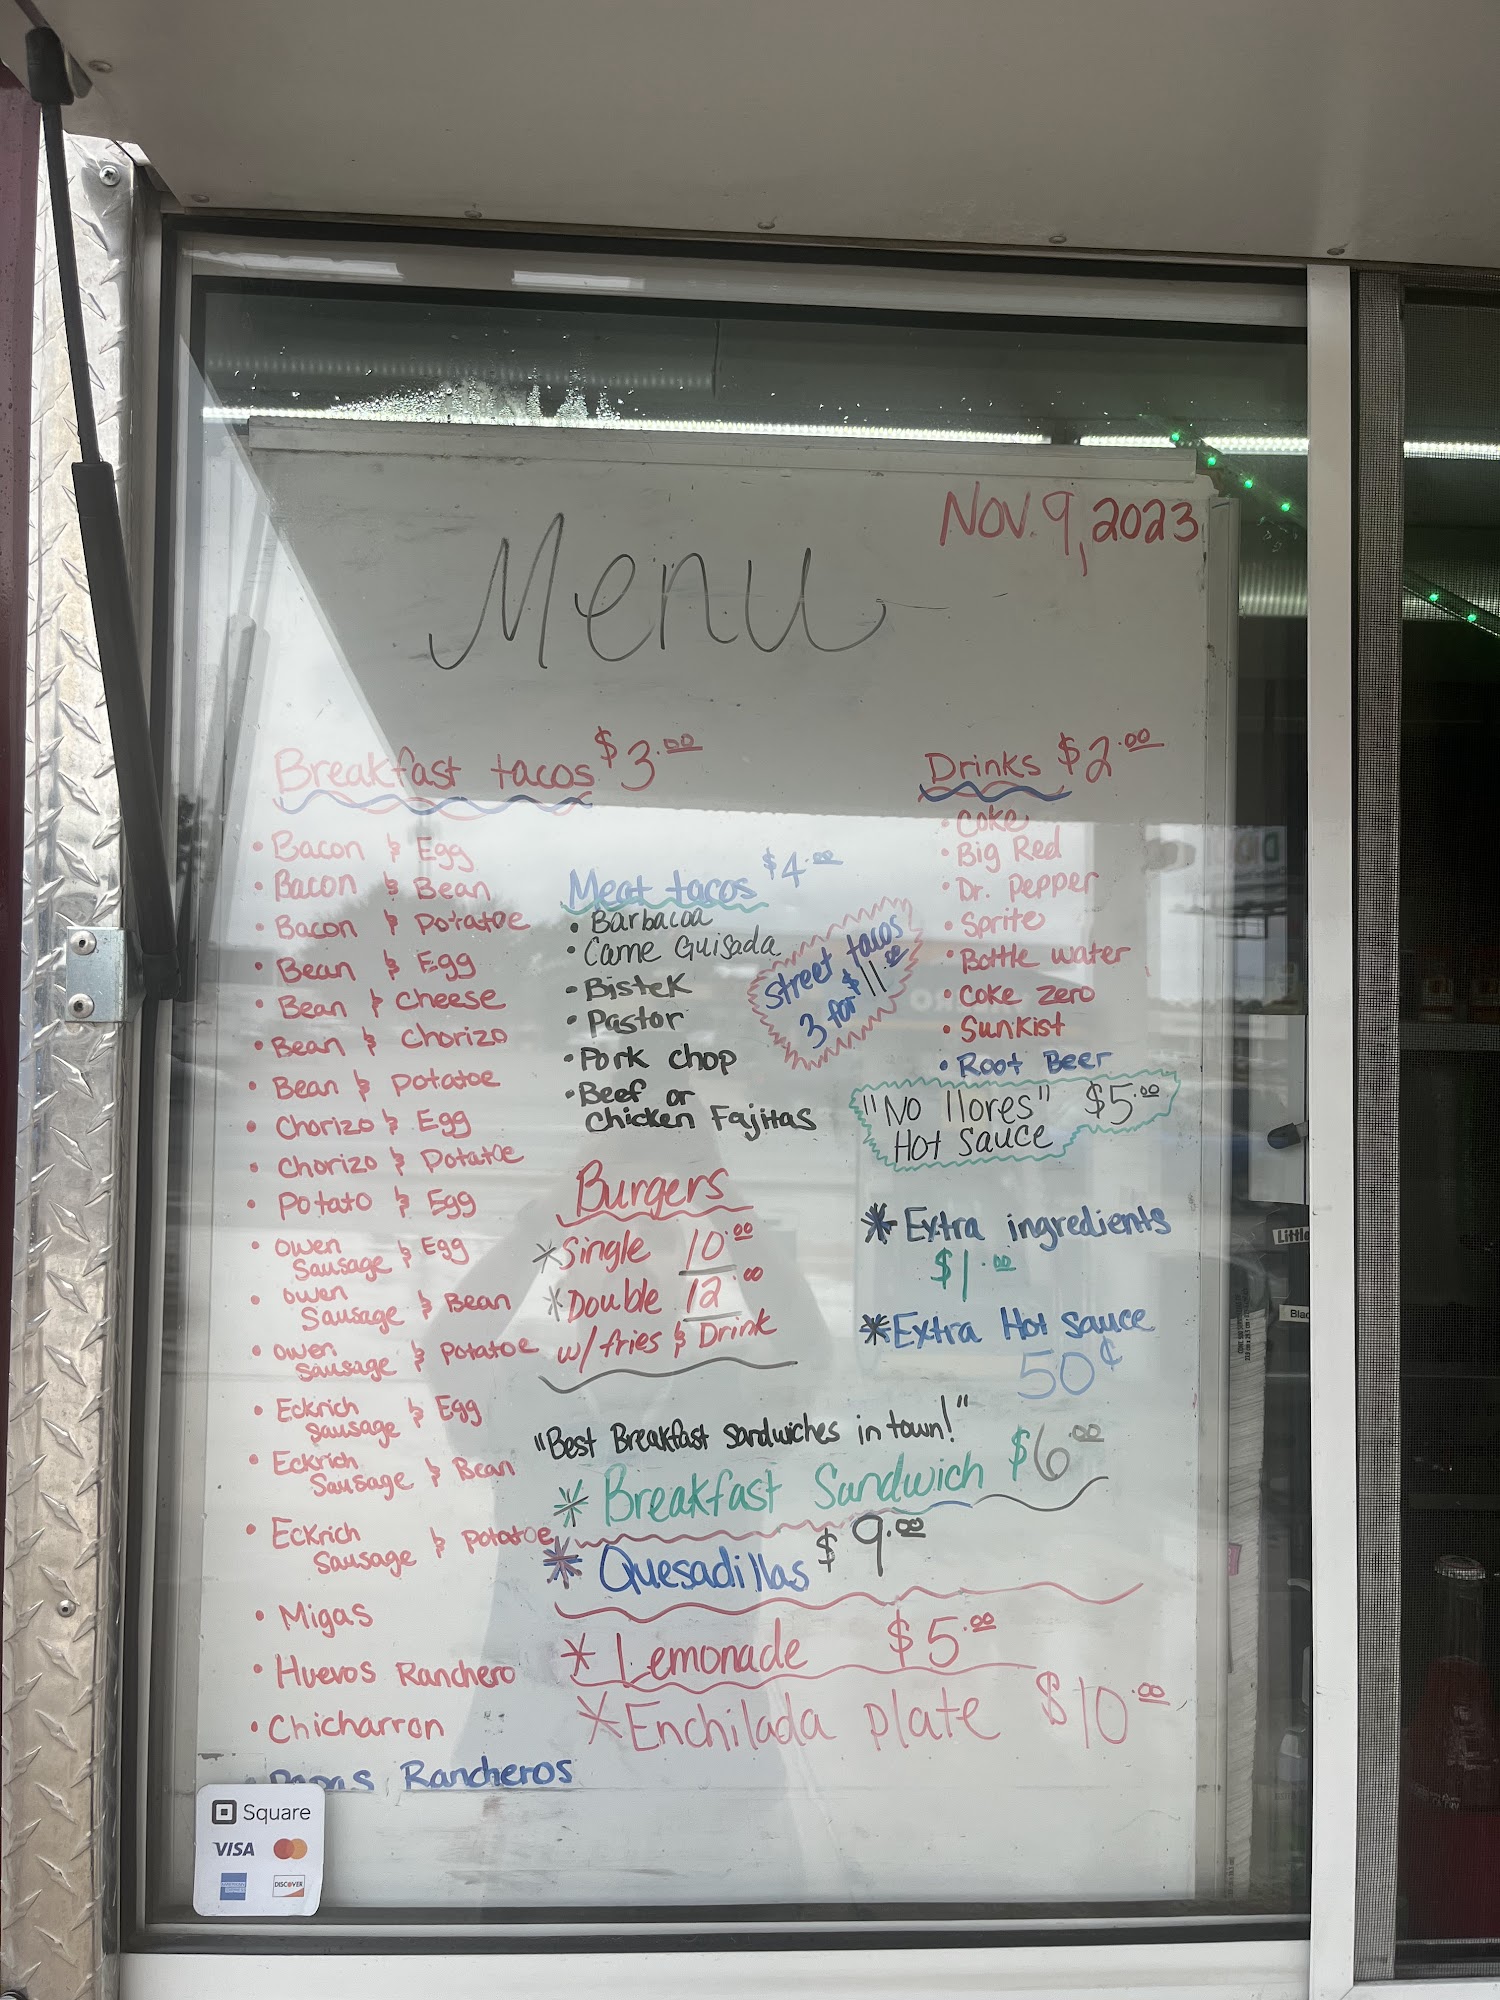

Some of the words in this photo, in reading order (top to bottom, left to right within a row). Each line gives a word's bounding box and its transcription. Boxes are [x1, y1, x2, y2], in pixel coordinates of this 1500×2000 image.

[429, 511, 887, 671] Menu
[274, 746, 461, 793] Breakfast
[491, 754, 595, 789] tacos
[925, 751, 1041, 784] Drinks
[956, 804, 1030, 838] Coke
[272, 830, 364, 862] Bacon
[417, 837, 474, 872] Egg
[956, 840, 1001, 873] Big
[1012, 824, 1062, 862] Red
[275, 869, 357, 901] Bacon
[413, 877, 490, 901] Bean
[569, 868, 653, 910] Meat
[665, 869, 758, 905] tacos
[955, 876, 991, 901] Dr.
[275, 914, 358, 940] Bacon
[591, 908, 713, 934] Barbacoa
[960, 907, 1046, 939] Sprite
[846, 914, 904, 968] tacos
[277, 957, 356, 983] Bean
[417, 951, 476, 981] Egg
[959, 943, 1041, 975] Bottle
[1051, 942, 1132, 965] water
[278, 995, 347, 1019] Bean
[959, 982, 1023, 1008] Coke
[587, 1006, 684, 1038] Pastor
[799, 1013, 828, 1049] 3
[827, 996, 856, 1028] for
[271, 1036, 346, 1058] Bean
[581, 1046, 650, 1071] Pork
[956, 1050, 1023, 1079] Root
[1043, 1049, 1114, 1074] Beer
[272, 1075, 339, 1100] Bean
[579, 1078, 647, 1107] Beef
[666, 1089, 696, 1107] or
[276, 1114, 375, 1140] Chorizo
[417, 1108, 472, 1139] Egg
[711, 1103, 818, 1142] Fajitas
[894, 1129, 941, 1163] Hot
[277, 1154, 378, 1179] Chorizo
[427, 1188, 477, 1220] Egg
[575, 1159, 730, 1220] Burgers
[904, 1206, 986, 1243] Extra
[1006, 1204, 1172, 1252] ingredients
[421, 1236, 470, 1265] Egg
[559, 1229, 651, 1273] Single
[444, 1292, 512, 1313] Bean
[567, 1277, 663, 1324] Double
[698, 1307, 778, 1349] Drink
[892, 1311, 982, 1349] Extra
[1000, 1306, 1048, 1341] Hot
[276, 1396, 359, 1423] Eckrich
[435, 1394, 482, 1427] Egg
[610, 1418, 710, 1454] Breakfast
[856, 1415, 882, 1445] in
[272, 1450, 358, 1476] Eckrich
[452, 1456, 516, 1482] Bean
[604, 1462, 783, 1527] Breakfast
[814, 1451, 984, 1510] Sandwich
[599, 1544, 809, 1595] Quesadillas
[278, 1601, 374, 1638] Migas
[616, 1617, 809, 1688] Lemonade
[274, 1653, 377, 1688] Huevos
[395, 1659, 516, 1688] Ranchero
[268, 1709, 445, 1744] Chicharron
[625, 1691, 837, 1752] Enchilada
[400, 1755, 573, 1790] Rancheros
[243, 1804, 311, 1825] Square
[212, 1842, 255, 1857] VISA
